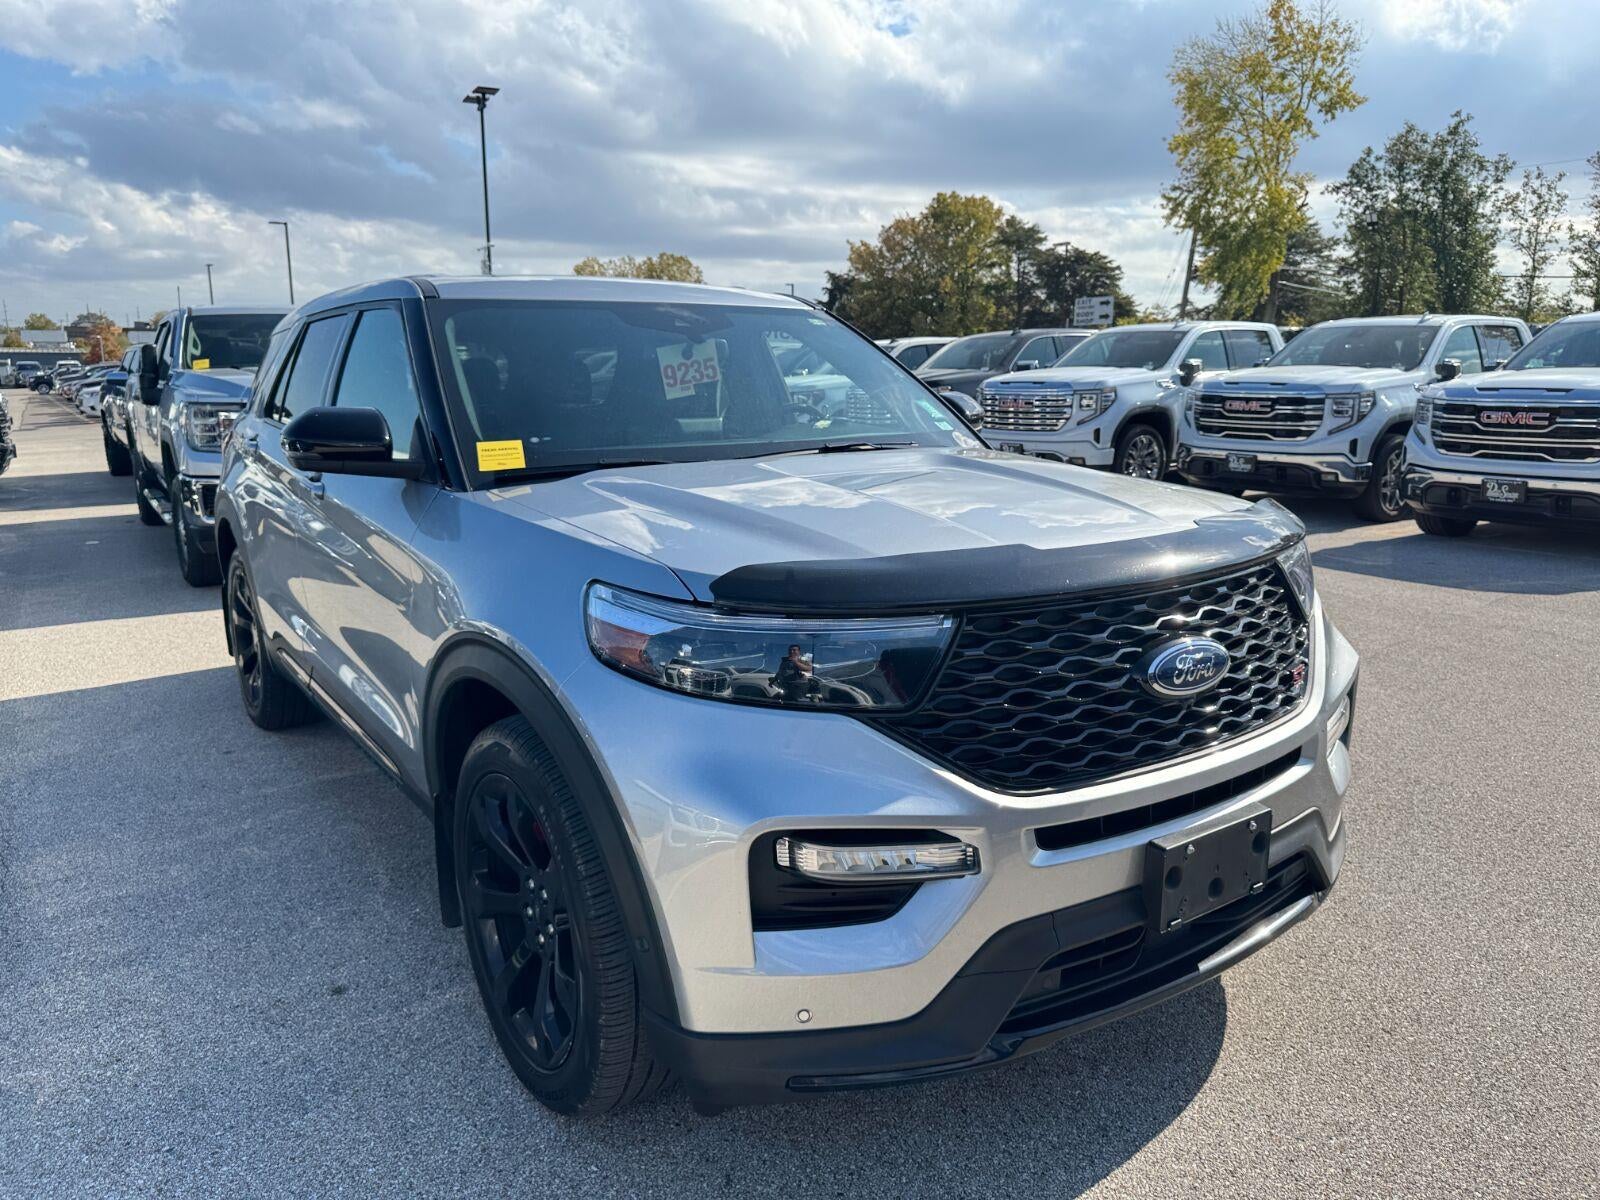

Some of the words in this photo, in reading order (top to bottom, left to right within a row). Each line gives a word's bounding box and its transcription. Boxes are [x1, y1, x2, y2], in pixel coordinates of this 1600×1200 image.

[663, 358, 719, 387] 9235
[1225, 400, 1272, 411] GMC
[1480, 410, 1550, 425] GMC
[1173, 652, 1216, 685] Ford
